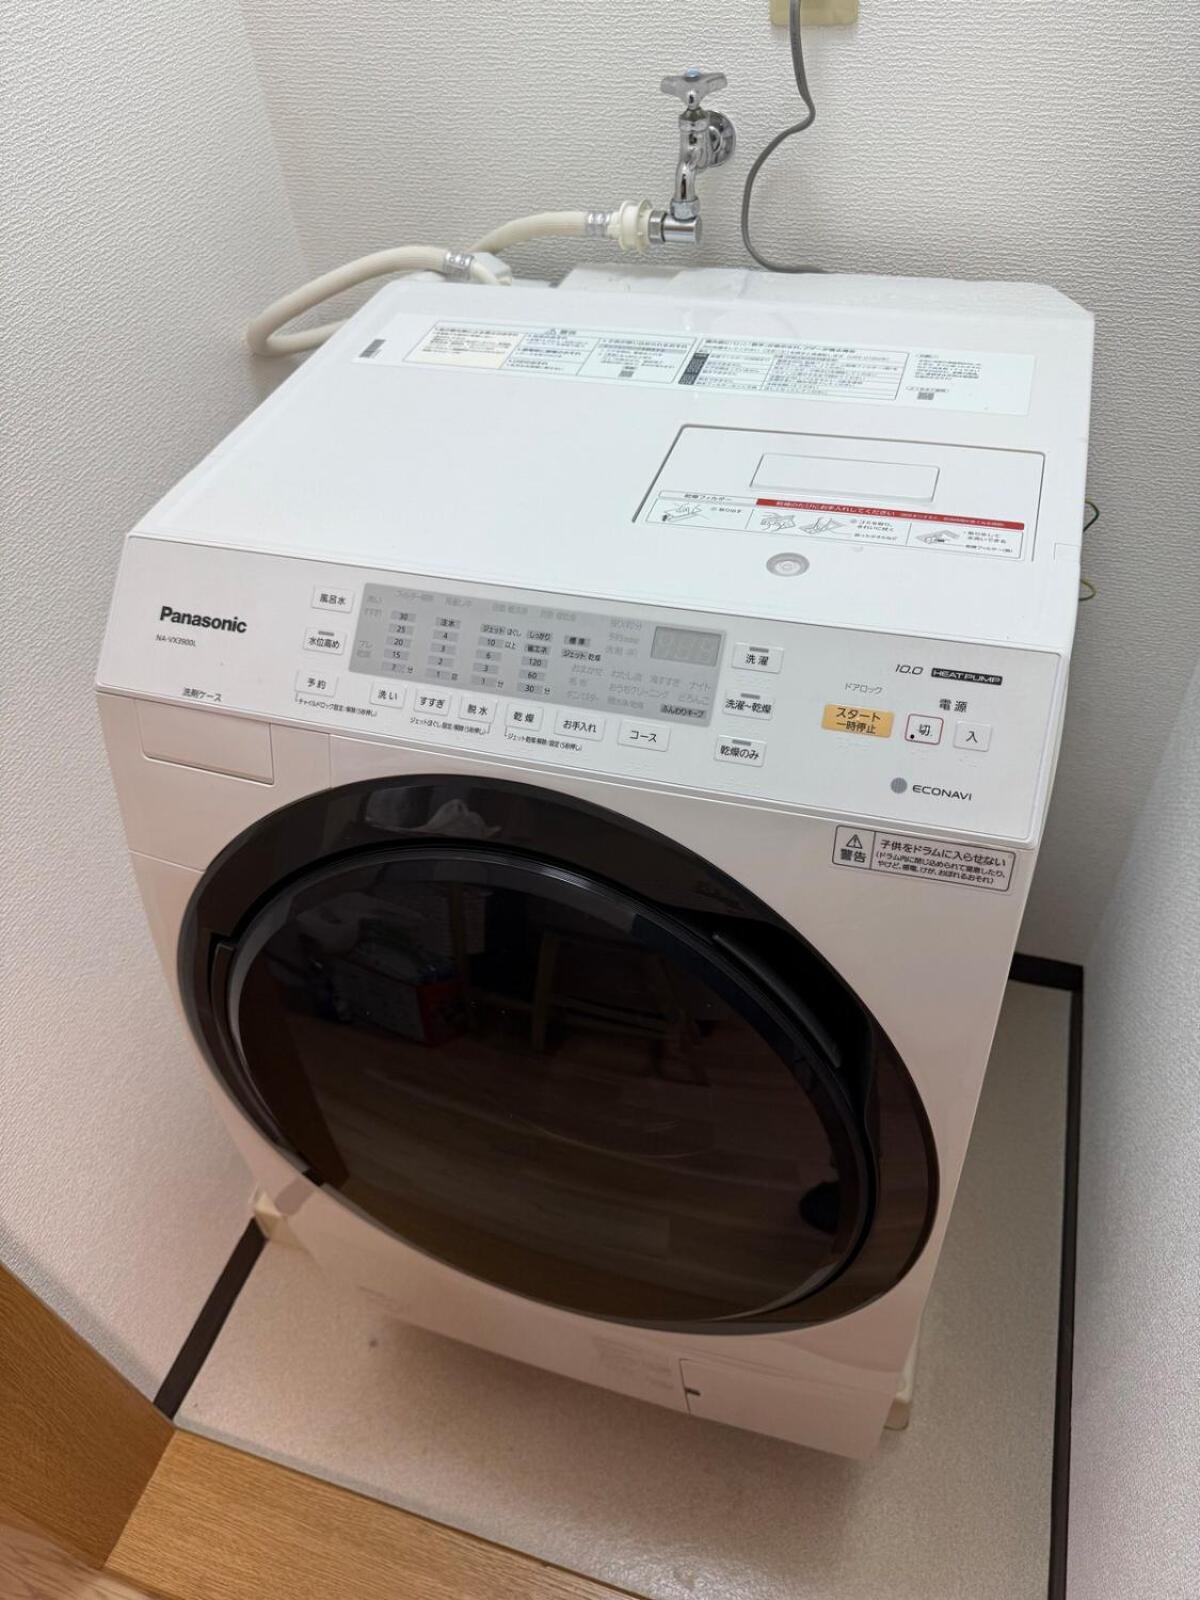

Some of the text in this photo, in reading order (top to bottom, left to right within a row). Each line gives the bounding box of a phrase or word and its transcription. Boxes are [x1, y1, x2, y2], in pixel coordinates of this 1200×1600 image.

[319, 592, 346, 605] 風呂水
[159, 605, 247, 634] Panasonic
[308, 636, 340, 650] 水位高め
[393, 638, 404, 646] 20
[392, 651, 401, 659] 15
[745, 653, 769, 666] 洗濯
[529, 658, 542, 667] 120
[527, 671, 538, 680] 60
[895, 663, 1001, 684] 10.0 HEAT PUMP
[306, 677, 327, 690] 予約
[525, 685, 535, 693] 30
[844, 682, 884, 696] ドアロック
[182, 686, 222, 702] 洗剤ケース
[377, 688, 398, 701] 洗い
[419, 695, 445, 709] すすぎ
[939, 697, 968, 713] 電源
[466, 703, 489, 716] 脱水
[836, 706, 881, 723] スタート
[513, 710, 535, 724] 乾燥
[562, 718, 597, 734] お手入れ
[836, 720, 877, 735] 一時停止
[918, 723, 931, 737] 切
[629, 730, 657, 743] コース
[966, 730, 978, 743] 入
[719, 743, 759, 761] 乾燥のみ
[912, 784, 972, 801] ECONAVI
[839, 847, 867, 864] 警告
[880, 838, 1006, 868] 子供をドラムに入らせない
